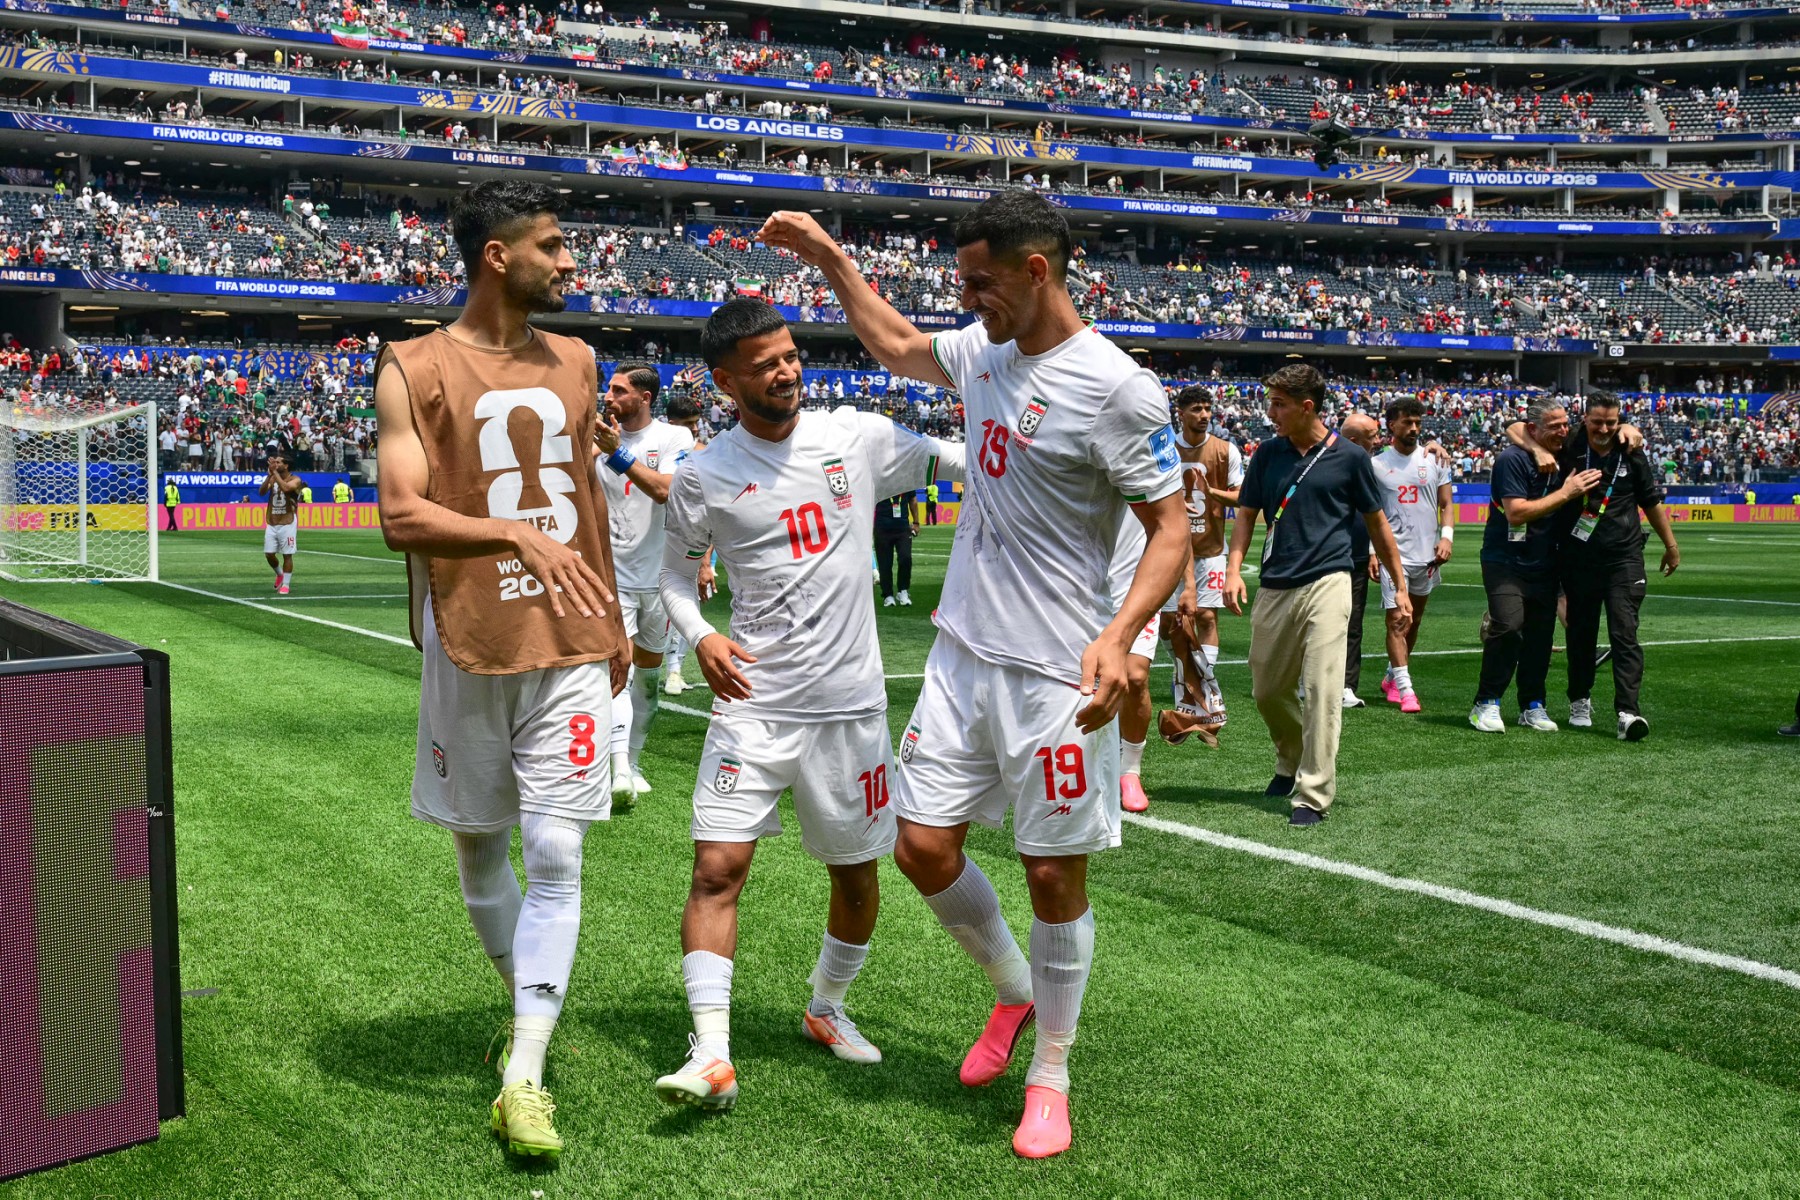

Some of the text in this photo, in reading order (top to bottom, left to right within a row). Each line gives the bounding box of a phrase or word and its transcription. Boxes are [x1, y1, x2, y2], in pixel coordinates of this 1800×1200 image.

[143, 15, 178, 25] ANGELES
[386, 40, 400, 49] CUP
[208, 70, 290, 94] #FIFAWorldCup
[696, 116, 844, 140] LOS ANGELES
[152, 126, 284, 146] FIFA WORLD CUP 2026
[452, 152, 526, 166] LOS ANGELES
[1192, 156, 1252, 172] #FIFAWorldCup
[1448, 172, 1597, 185] FIFA WORLD CUP 2026
[929, 188, 991, 200] LOS ANGELES
[1124, 201, 1217, 214] FIFA WORLD CUP 2026
[1342, 214, 1398, 225] LOS ANGELES
[0, 270, 56, 282] ANGELES
[216, 281, 336, 296] FIFA WORLD CUP 2026
[918, 316, 956, 324] ANGELES
[1094, 324, 1156, 334] ORLD CUP 2026
[1262, 330, 1313, 340] LOS ANGELES
[850, 374, 886, 386] LOS
[978, 418, 1010, 479] 19
[190, 476, 229, 484] WORLD
[230, 476, 252, 484] CUP
[1398, 485, 1418, 504] 23
[182, 507, 231, 528] PLAY.
[297, 506, 343, 526] HAVE
[1692, 510, 1713, 520] FIFA
[778, 502, 830, 560] 10
[1190, 525, 1206, 534] 26
[1208, 571, 1224, 590] 26
[568, 714, 595, 766] 8
[1034, 744, 1088, 801] 19
[858, 762, 890, 818] 10
